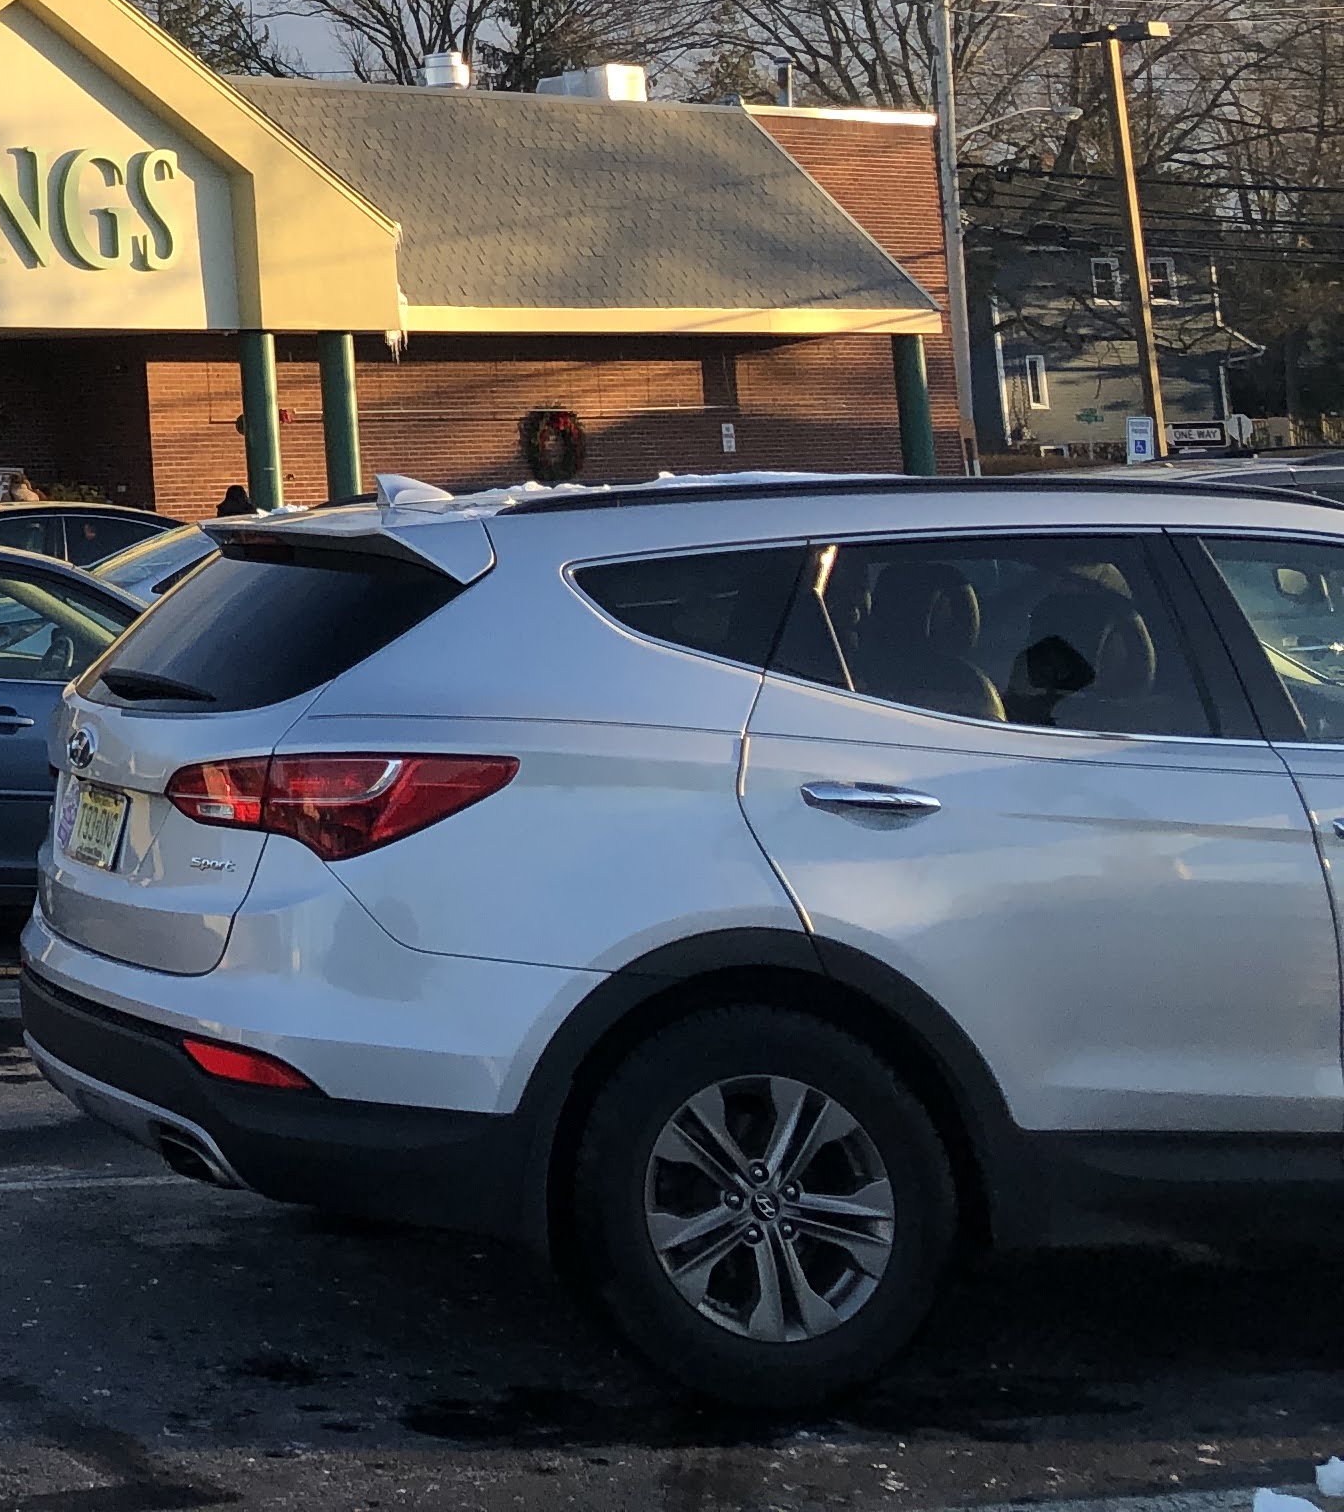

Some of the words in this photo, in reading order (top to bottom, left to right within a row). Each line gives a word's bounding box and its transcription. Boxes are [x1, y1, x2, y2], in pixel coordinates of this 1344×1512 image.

[1174, 428, 1194, 439] ONE
[1197, 428, 1218, 439] WAY
[190, 856, 237, 873] Sport
